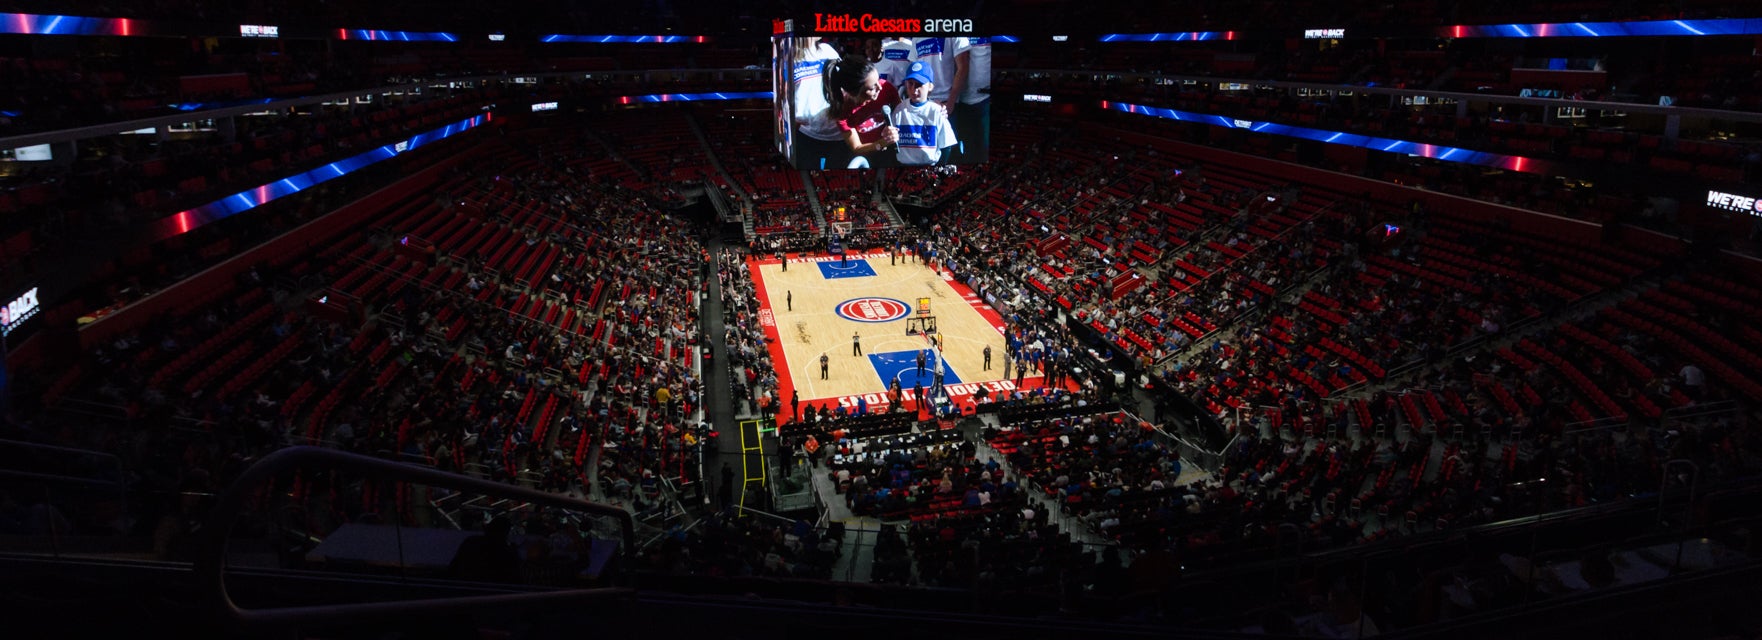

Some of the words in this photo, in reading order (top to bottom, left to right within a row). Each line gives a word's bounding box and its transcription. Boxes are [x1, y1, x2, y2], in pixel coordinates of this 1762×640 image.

[815, 13, 858, 32] Little
[860, 13, 921, 32] Caesars
[924, 18, 973, 32] arena
[1328, 28, 1345, 36] BACK
[1707, 190, 1755, 210] WE'RE
[8, 287, 39, 323] BACK
[945, 380, 1016, 397] DETROI
